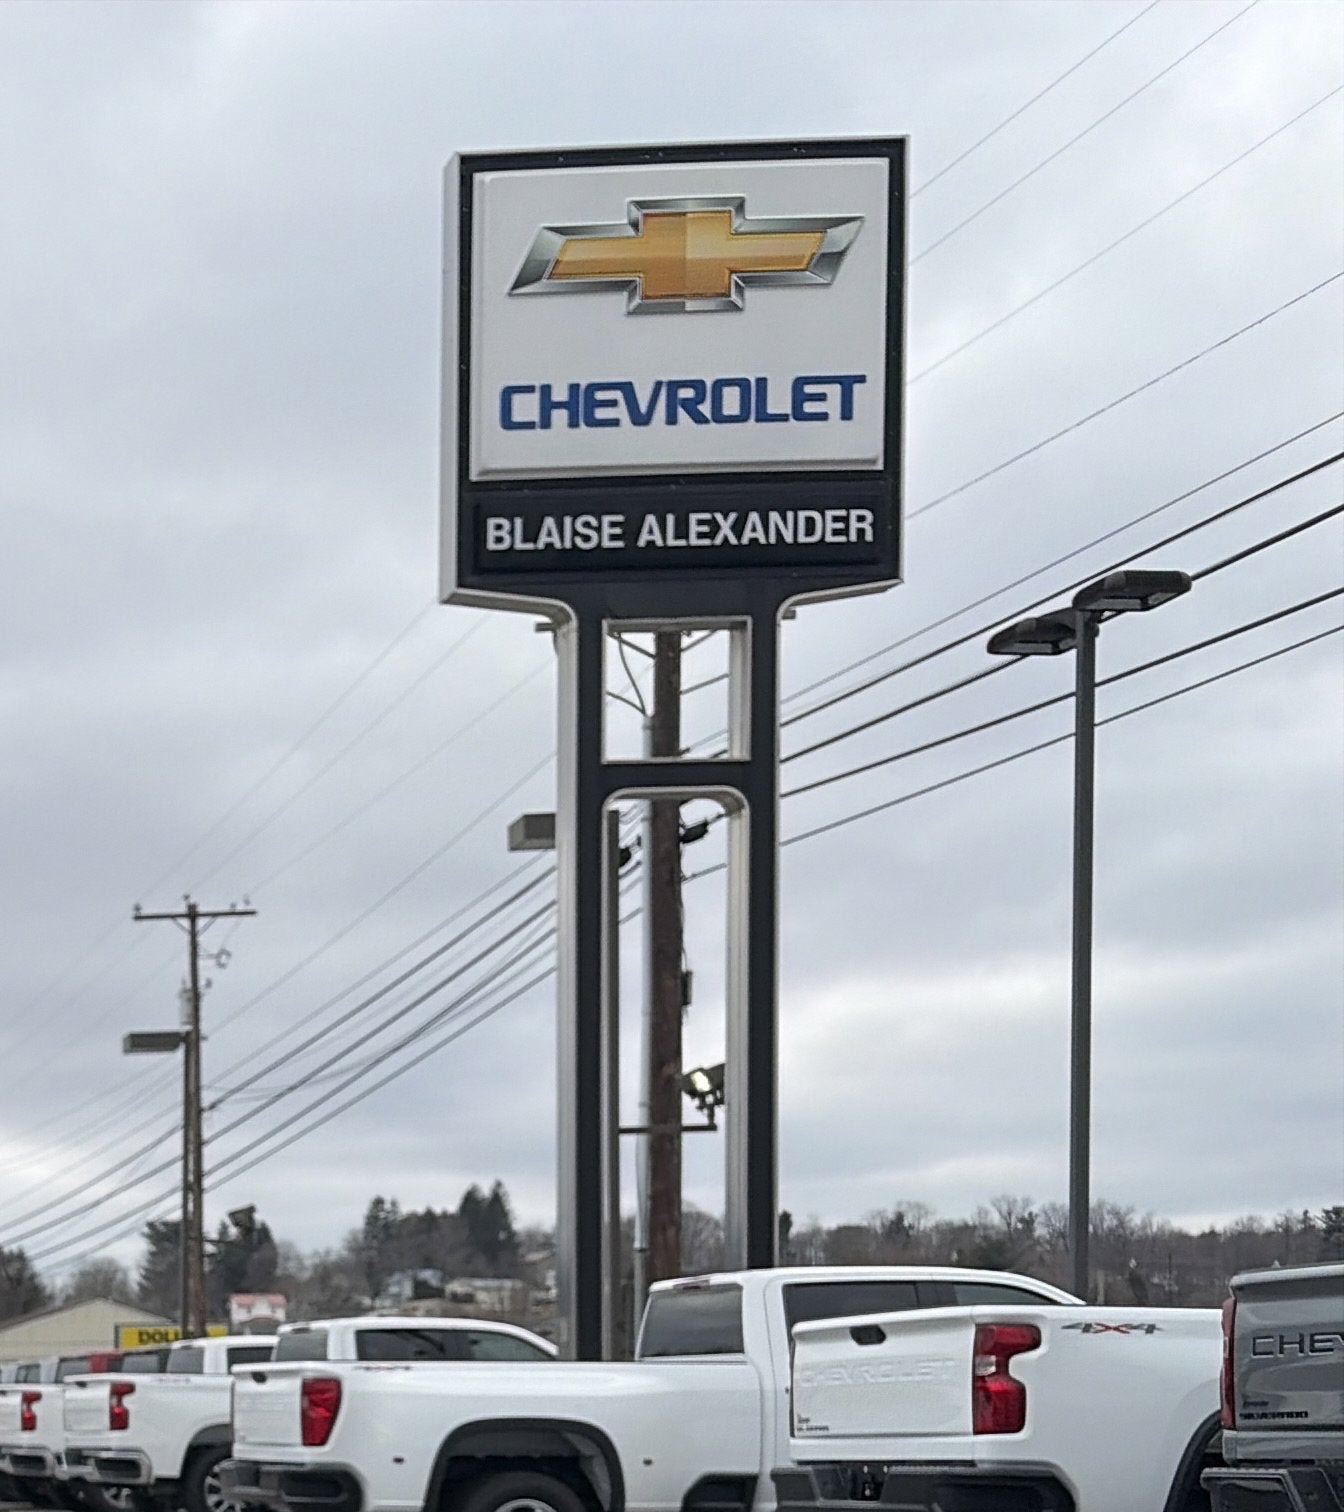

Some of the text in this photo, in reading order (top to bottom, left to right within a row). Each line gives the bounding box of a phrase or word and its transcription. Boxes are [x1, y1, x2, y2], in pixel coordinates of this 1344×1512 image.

[499, 374, 866, 430] CHEVROLET
[485, 508, 875, 551] BLAISE ALEXANDER
